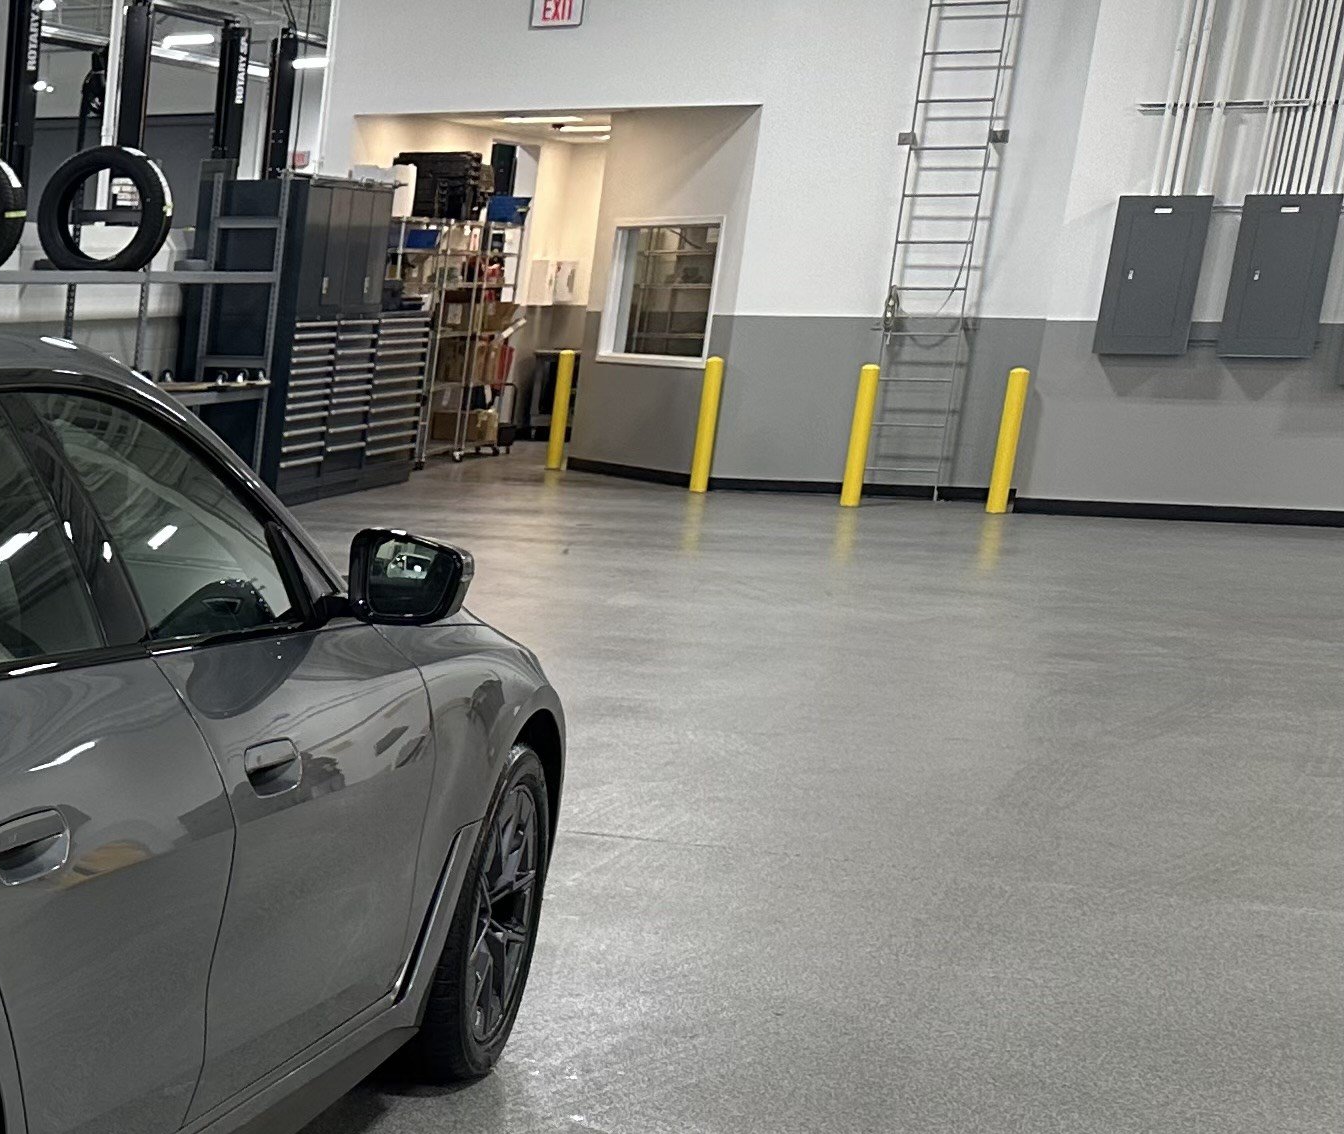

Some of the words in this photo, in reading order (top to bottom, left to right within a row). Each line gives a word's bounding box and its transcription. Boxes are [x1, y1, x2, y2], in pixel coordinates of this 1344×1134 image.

[541, 0, 574, 20] EXIT
[26, 12, 40, 71] ROTARY
[234, 55, 247, 104] ROTARY
